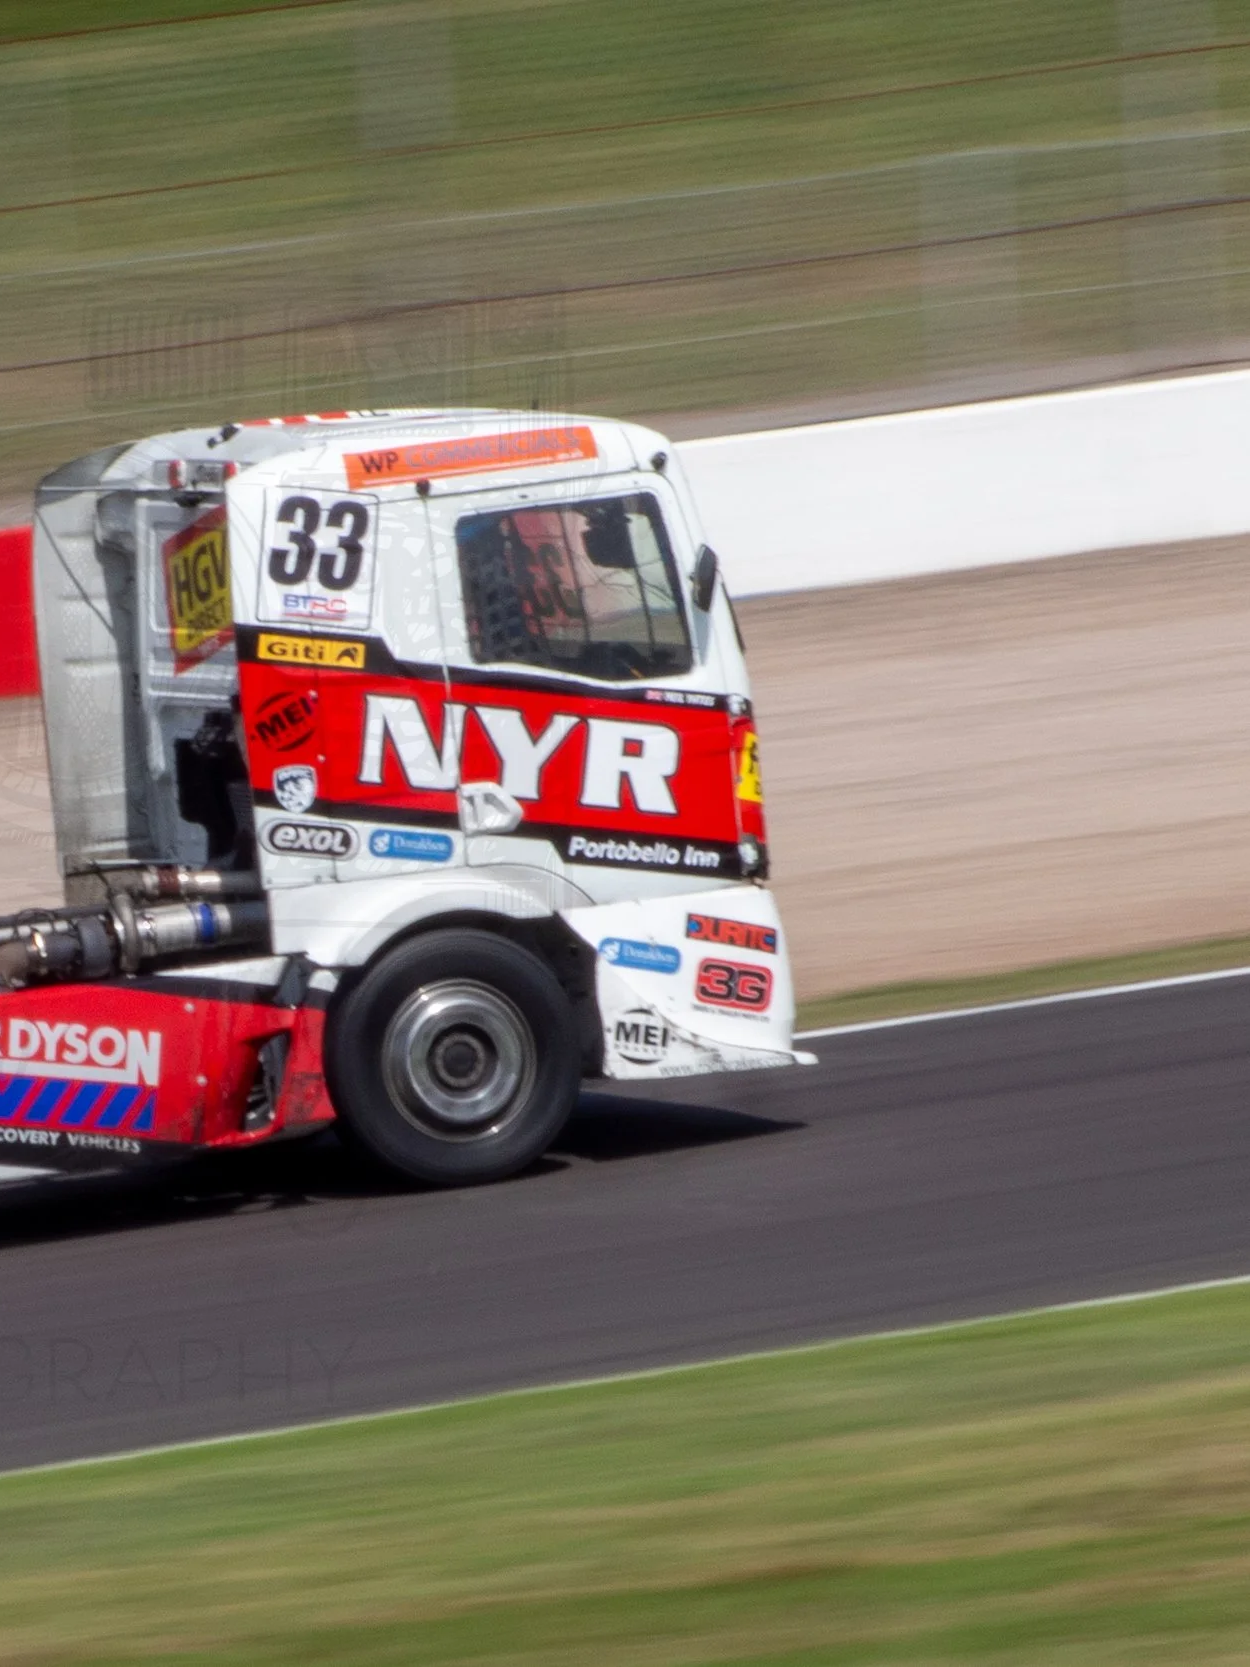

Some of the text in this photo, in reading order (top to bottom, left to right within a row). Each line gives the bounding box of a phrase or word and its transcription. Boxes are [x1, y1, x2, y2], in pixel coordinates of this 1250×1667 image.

[359, 451, 398, 474] WP
[268, 495, 369, 591] 33
[173, 532, 227, 617] HGV
[283, 593, 348, 614] BTRC
[267, 641, 323, 660] Giti
[255, 696, 313, 744] MEI
[358, 694, 680, 816] NYR
[568, 835, 720, 867] Portobello Inn
[701, 963, 767, 1004] 3G
[8, 1017, 162, 1087] DYSON
[615, 1021, 669, 1048] MEI
[67, 1133, 141, 1154] VEHICLES
